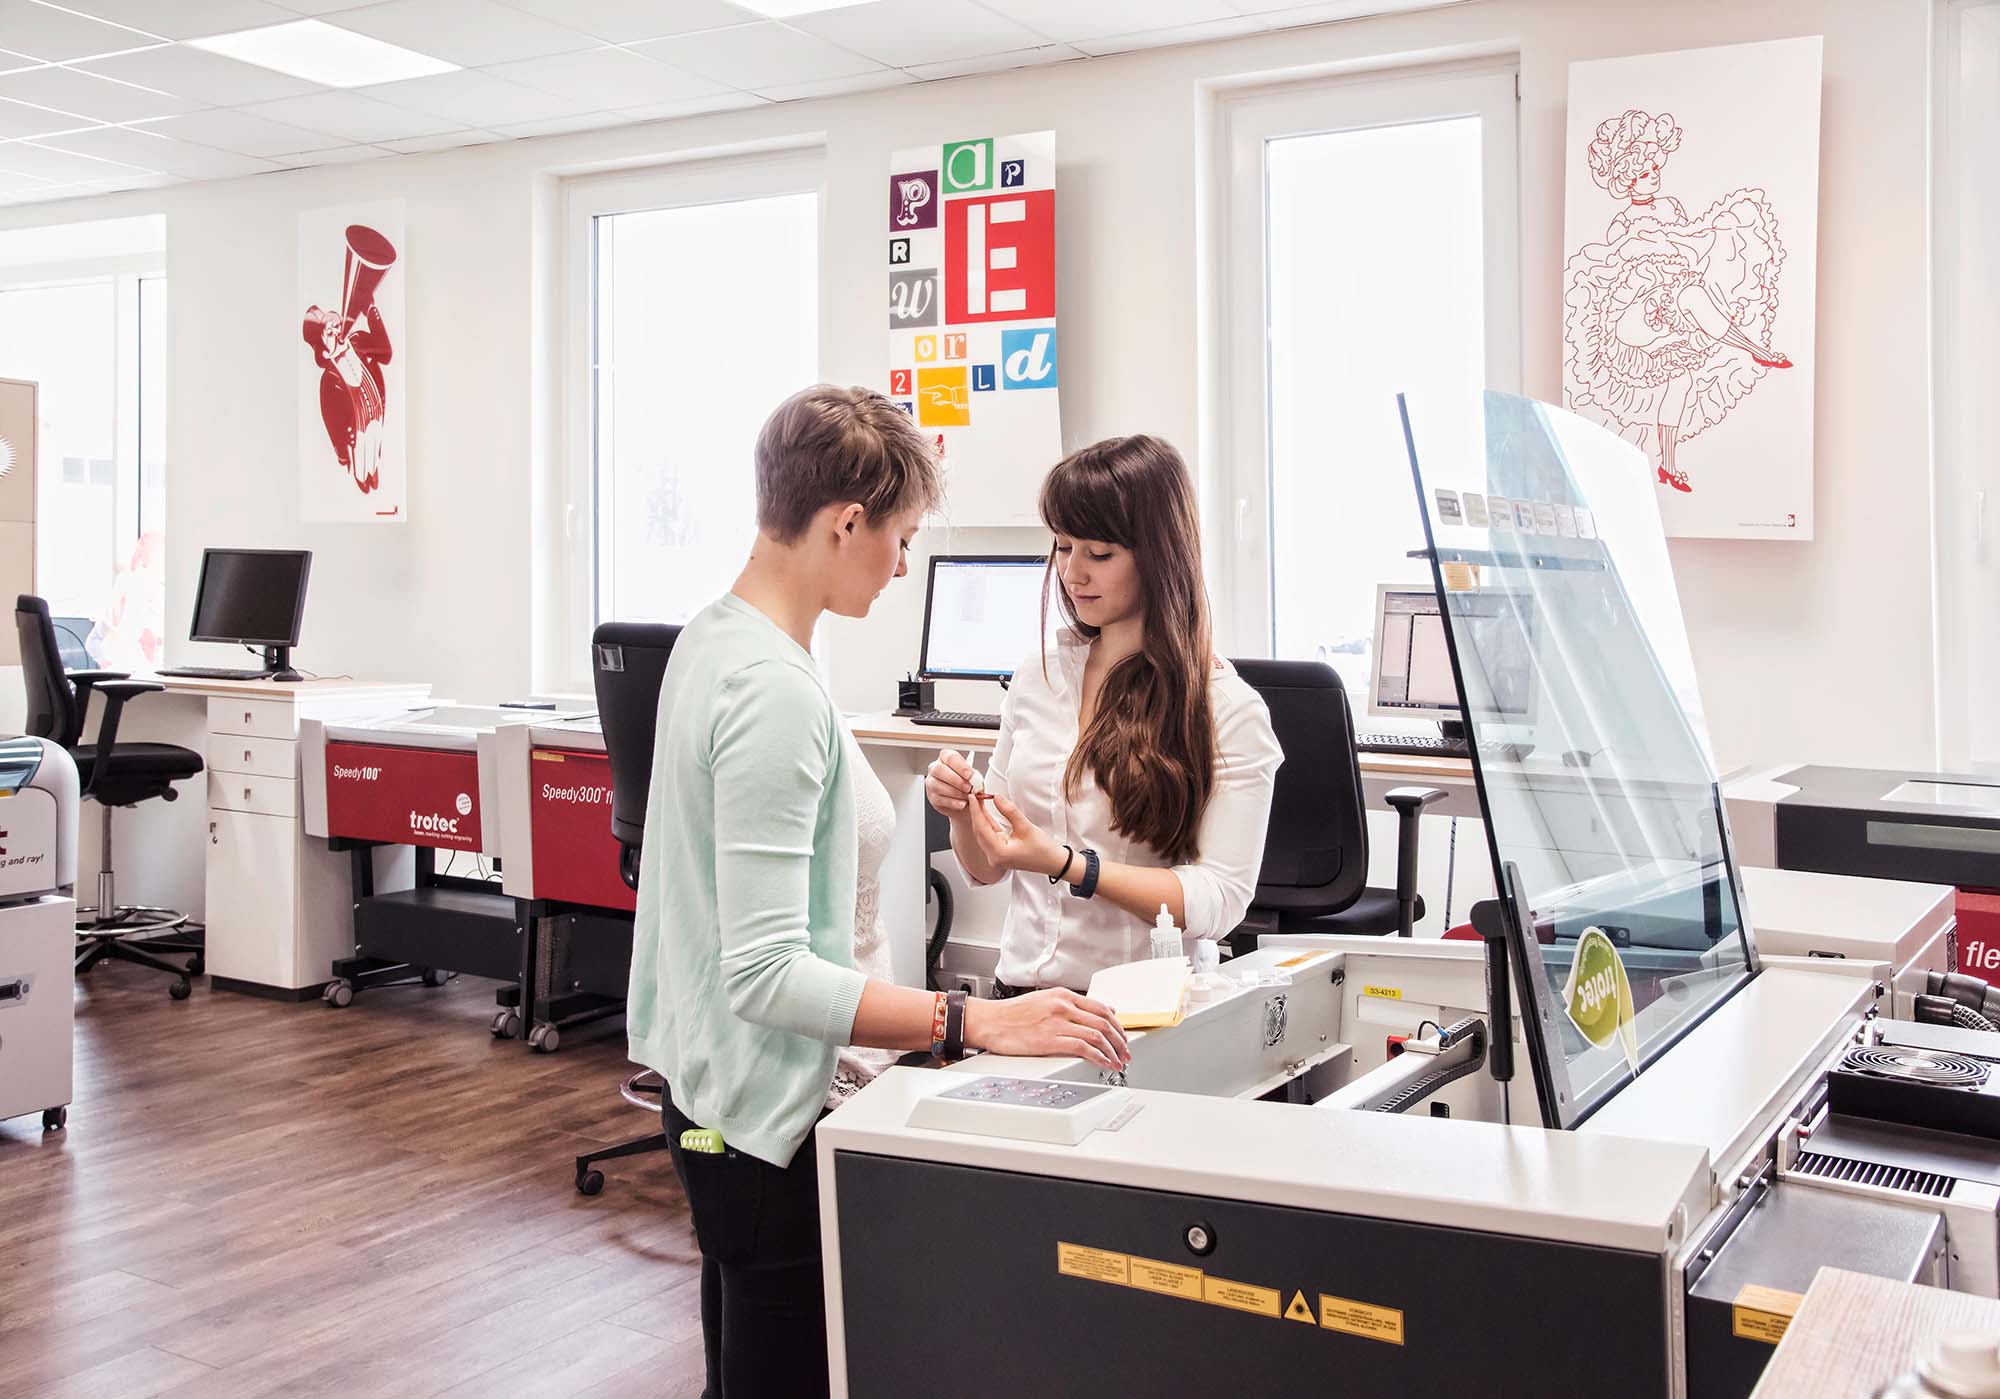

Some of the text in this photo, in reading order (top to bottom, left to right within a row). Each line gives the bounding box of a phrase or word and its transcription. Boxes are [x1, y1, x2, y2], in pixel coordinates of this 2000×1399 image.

[896, 178, 931, 226] P
[892, 241, 908, 262] R
[967, 199, 1026, 315] E
[1005, 333, 1052, 382] d
[895, 372, 906, 393] 2
[978, 367, 991, 390] L
[409, 810, 459, 833] trotec
[8, 855, 25, 866] and
